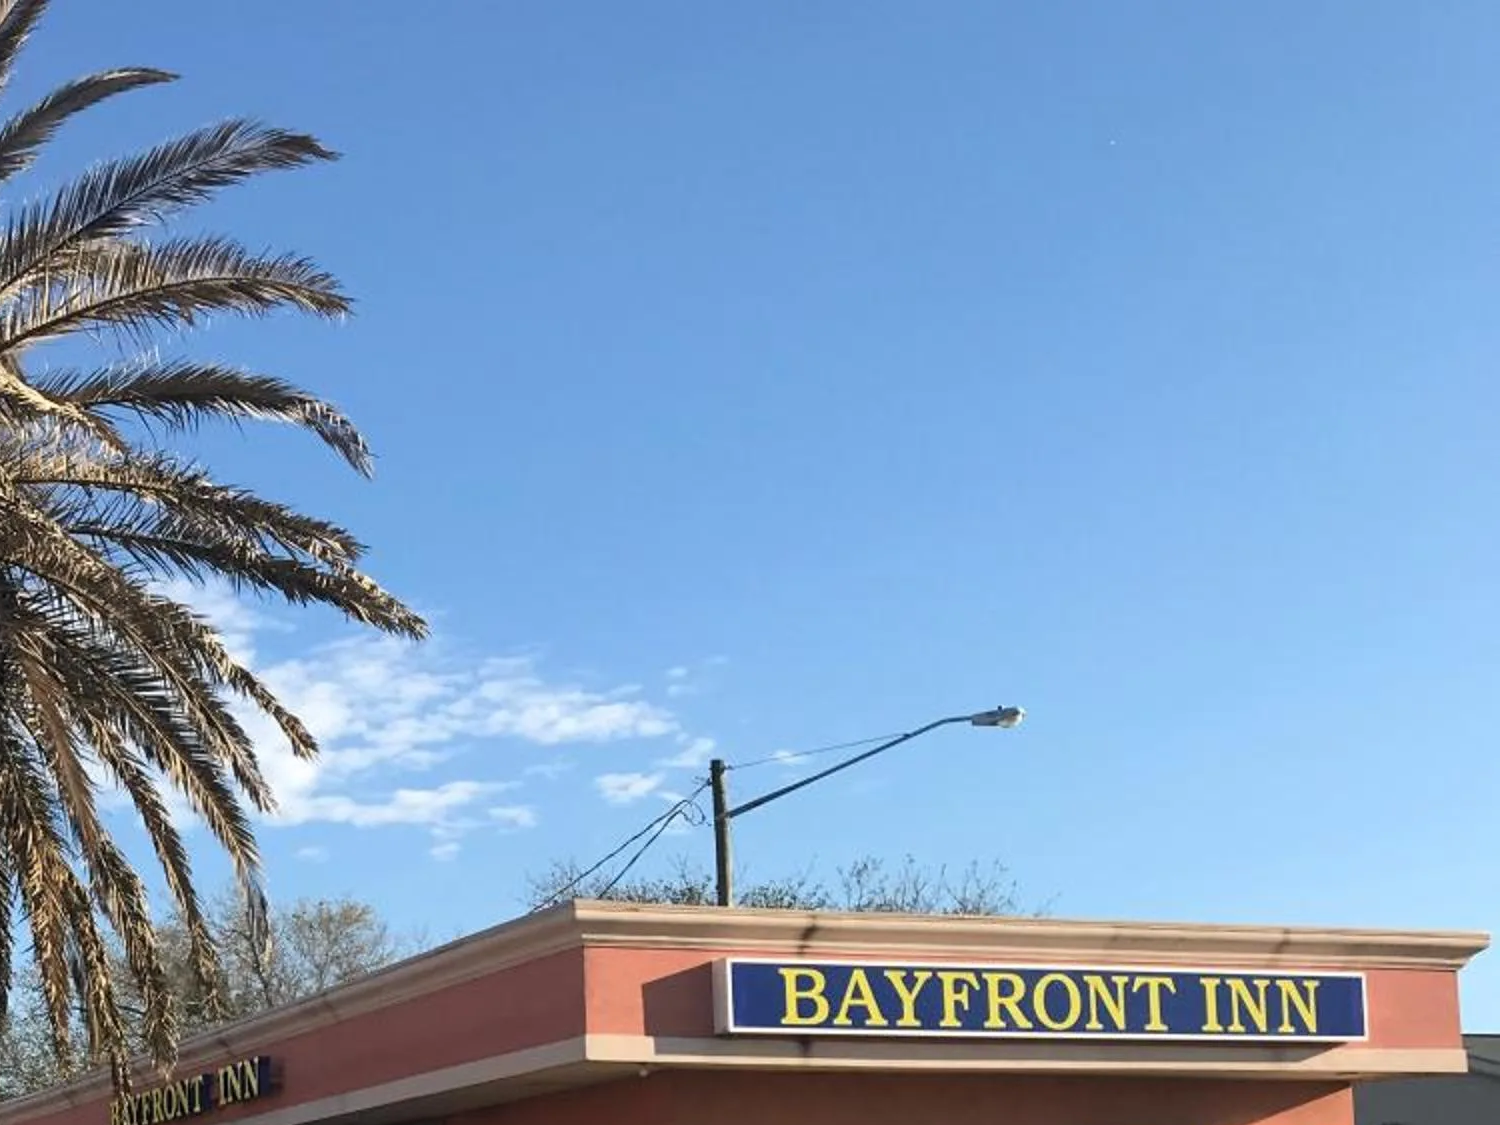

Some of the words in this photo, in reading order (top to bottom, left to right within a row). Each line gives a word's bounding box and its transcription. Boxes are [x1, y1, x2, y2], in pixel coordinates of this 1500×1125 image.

[778, 967, 1176, 1033] BAYFRONT
[1200, 976, 1321, 1034] INN
[218, 1056, 260, 1105] INN
